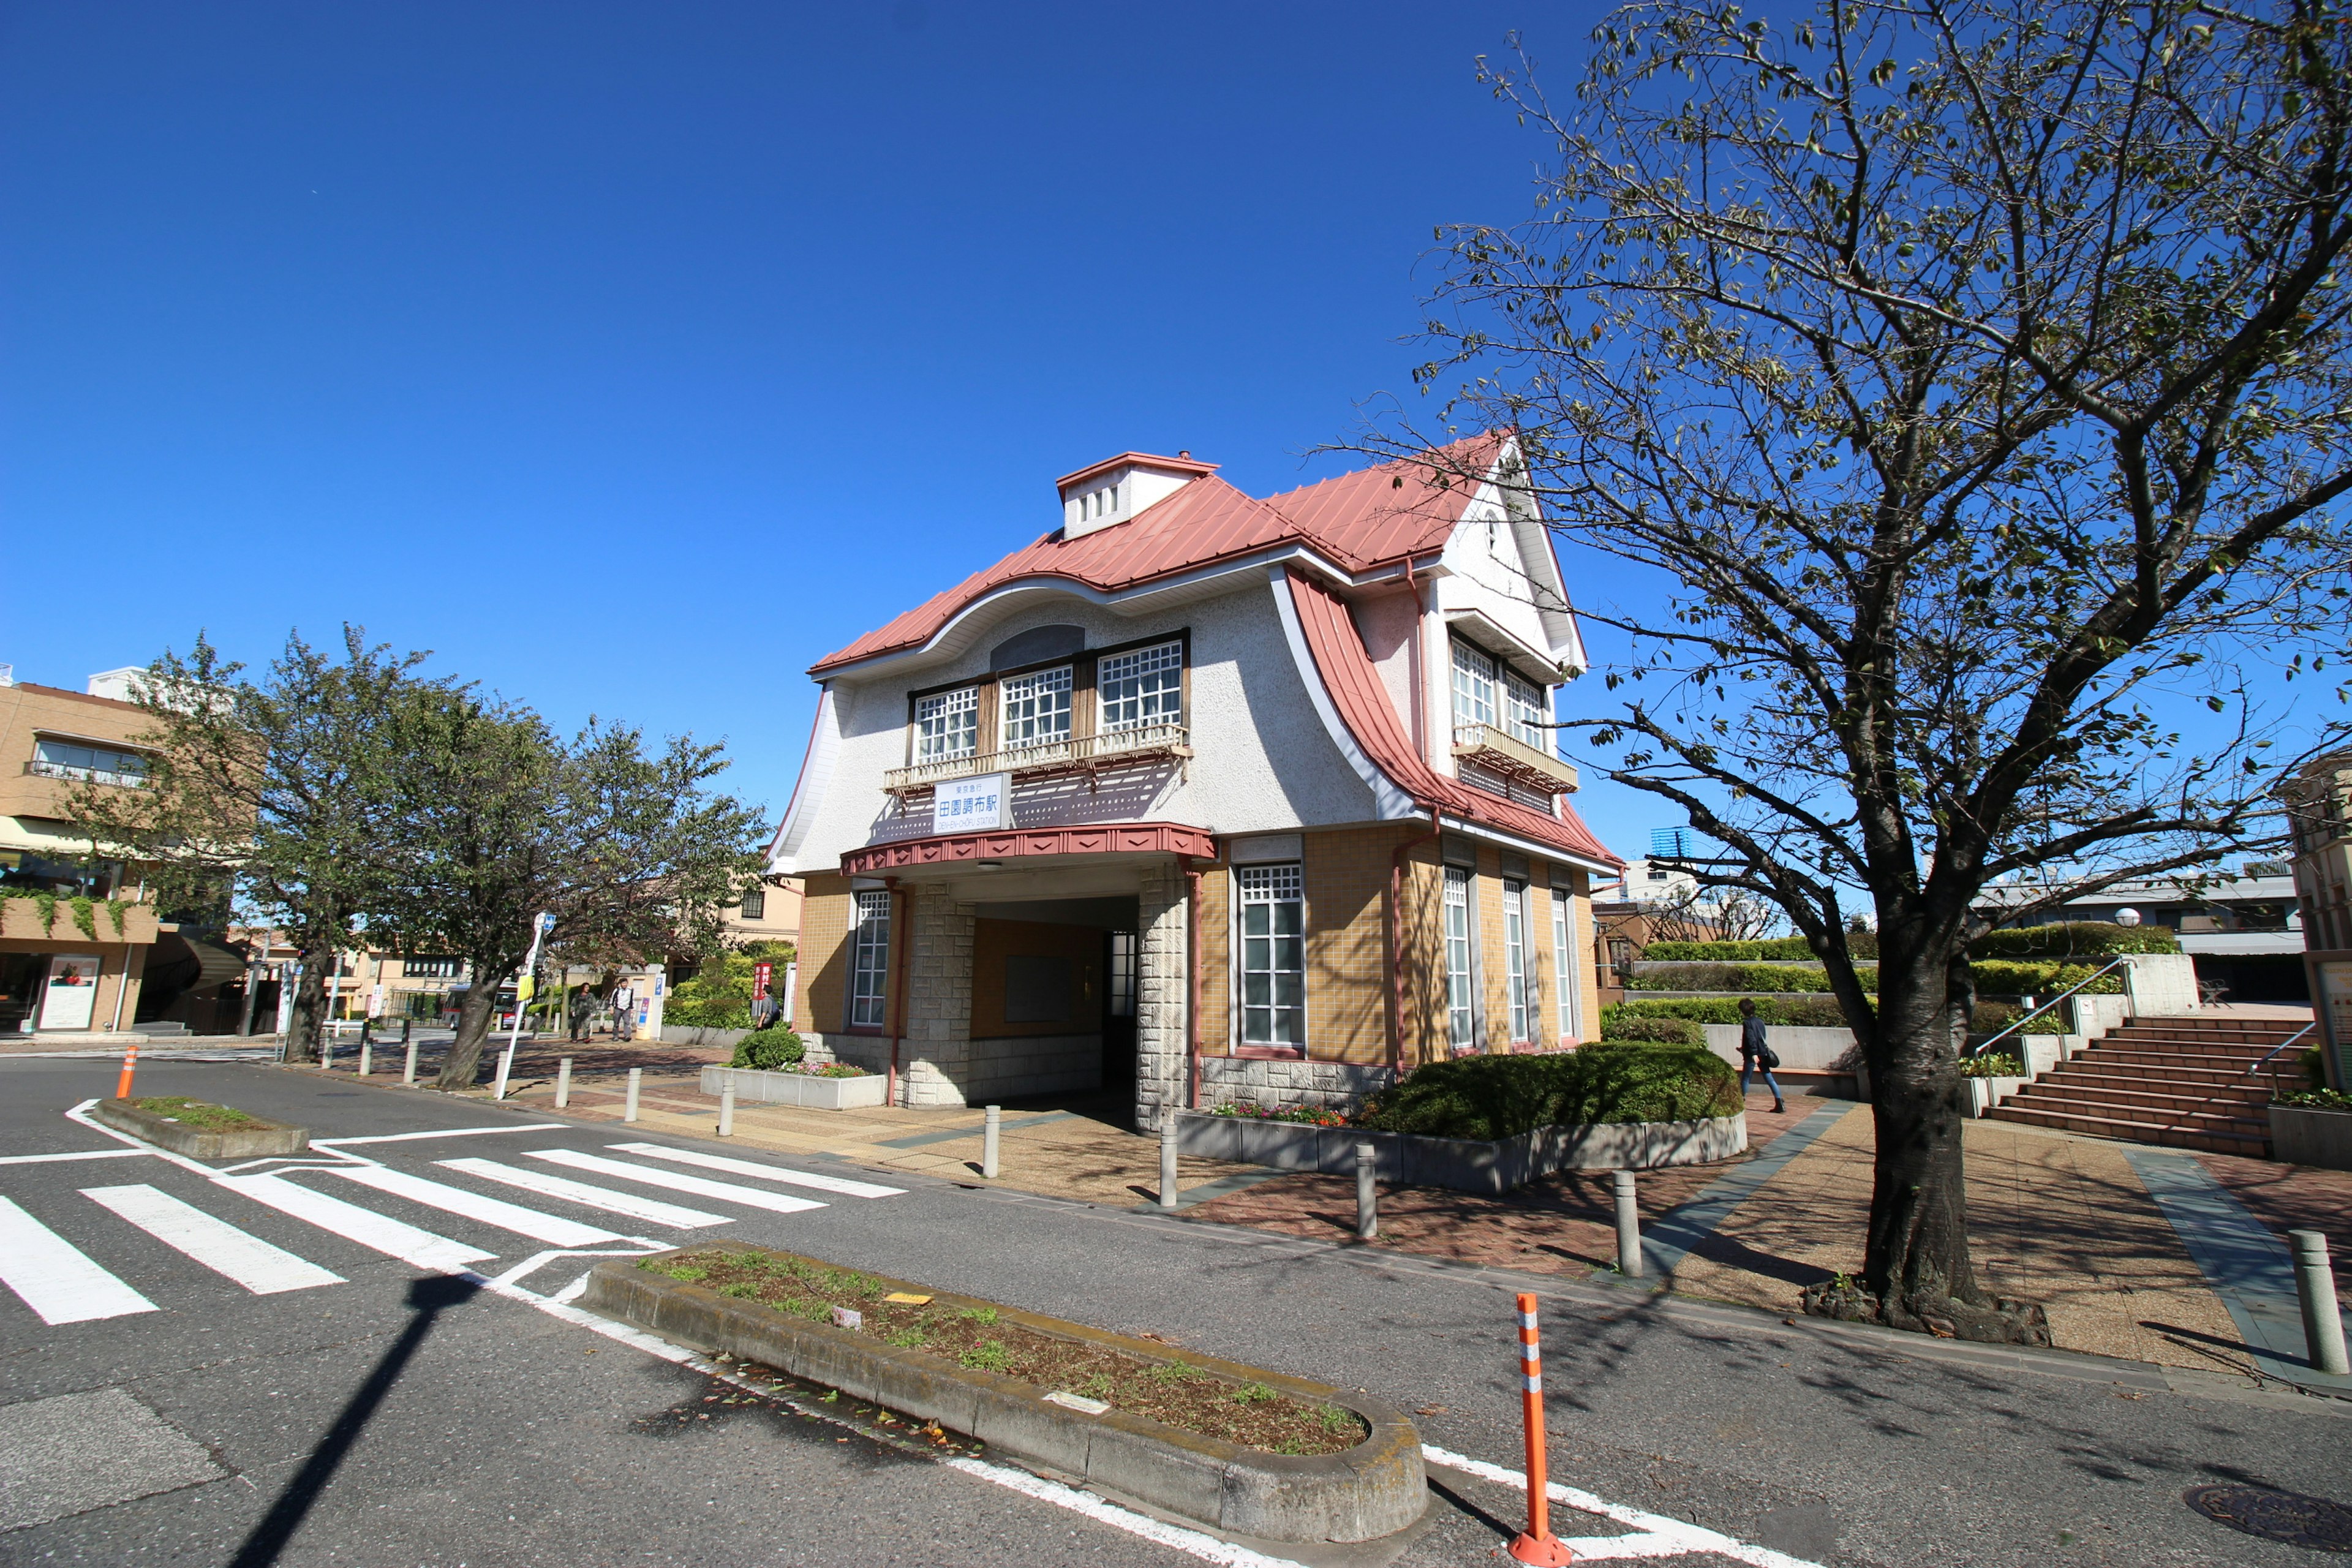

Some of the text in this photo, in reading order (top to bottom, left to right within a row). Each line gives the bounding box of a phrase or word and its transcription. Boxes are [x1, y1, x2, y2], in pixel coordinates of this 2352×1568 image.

[956, 784, 981, 793] 東京急行
[940, 794, 997, 816] 田園調布駅
[977, 816, 997, 826] STATION
[657, 979, 661, 987] P
